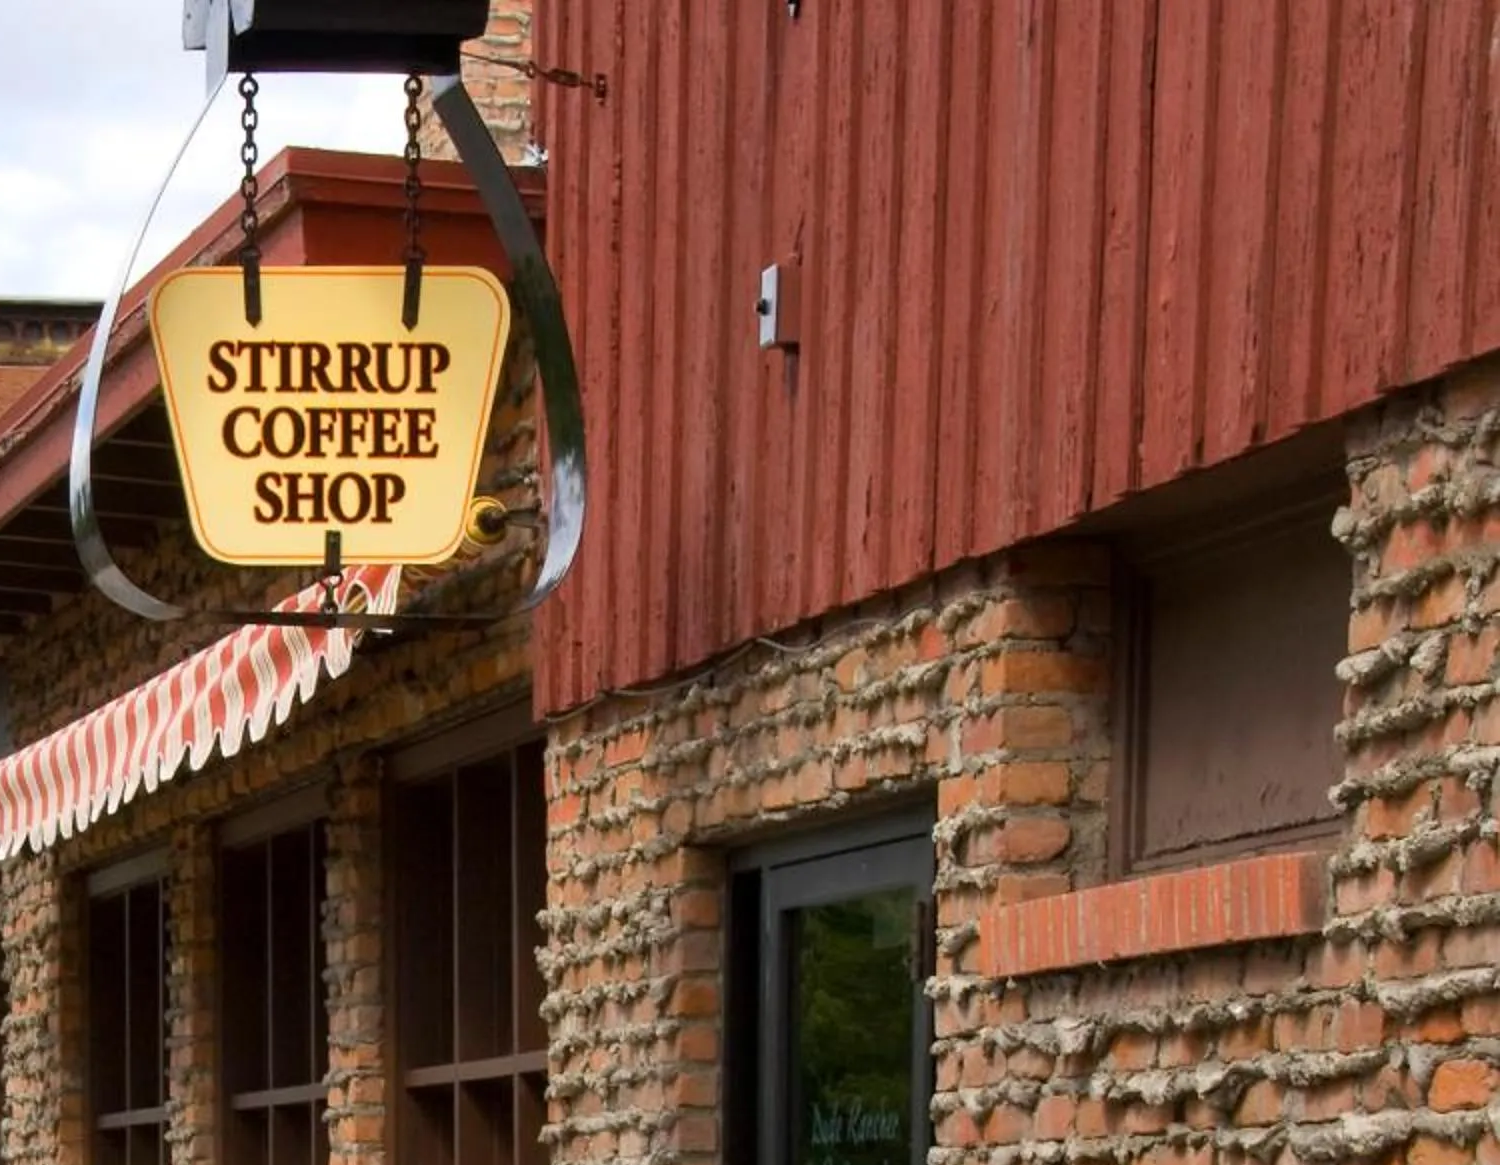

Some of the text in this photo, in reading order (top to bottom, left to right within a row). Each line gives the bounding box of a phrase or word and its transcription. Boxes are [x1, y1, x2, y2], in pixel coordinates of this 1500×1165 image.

[206, 340, 451, 394] STIRRUP
[222, 406, 439, 459] COFFEE
[253, 471, 406, 524] SHOP
